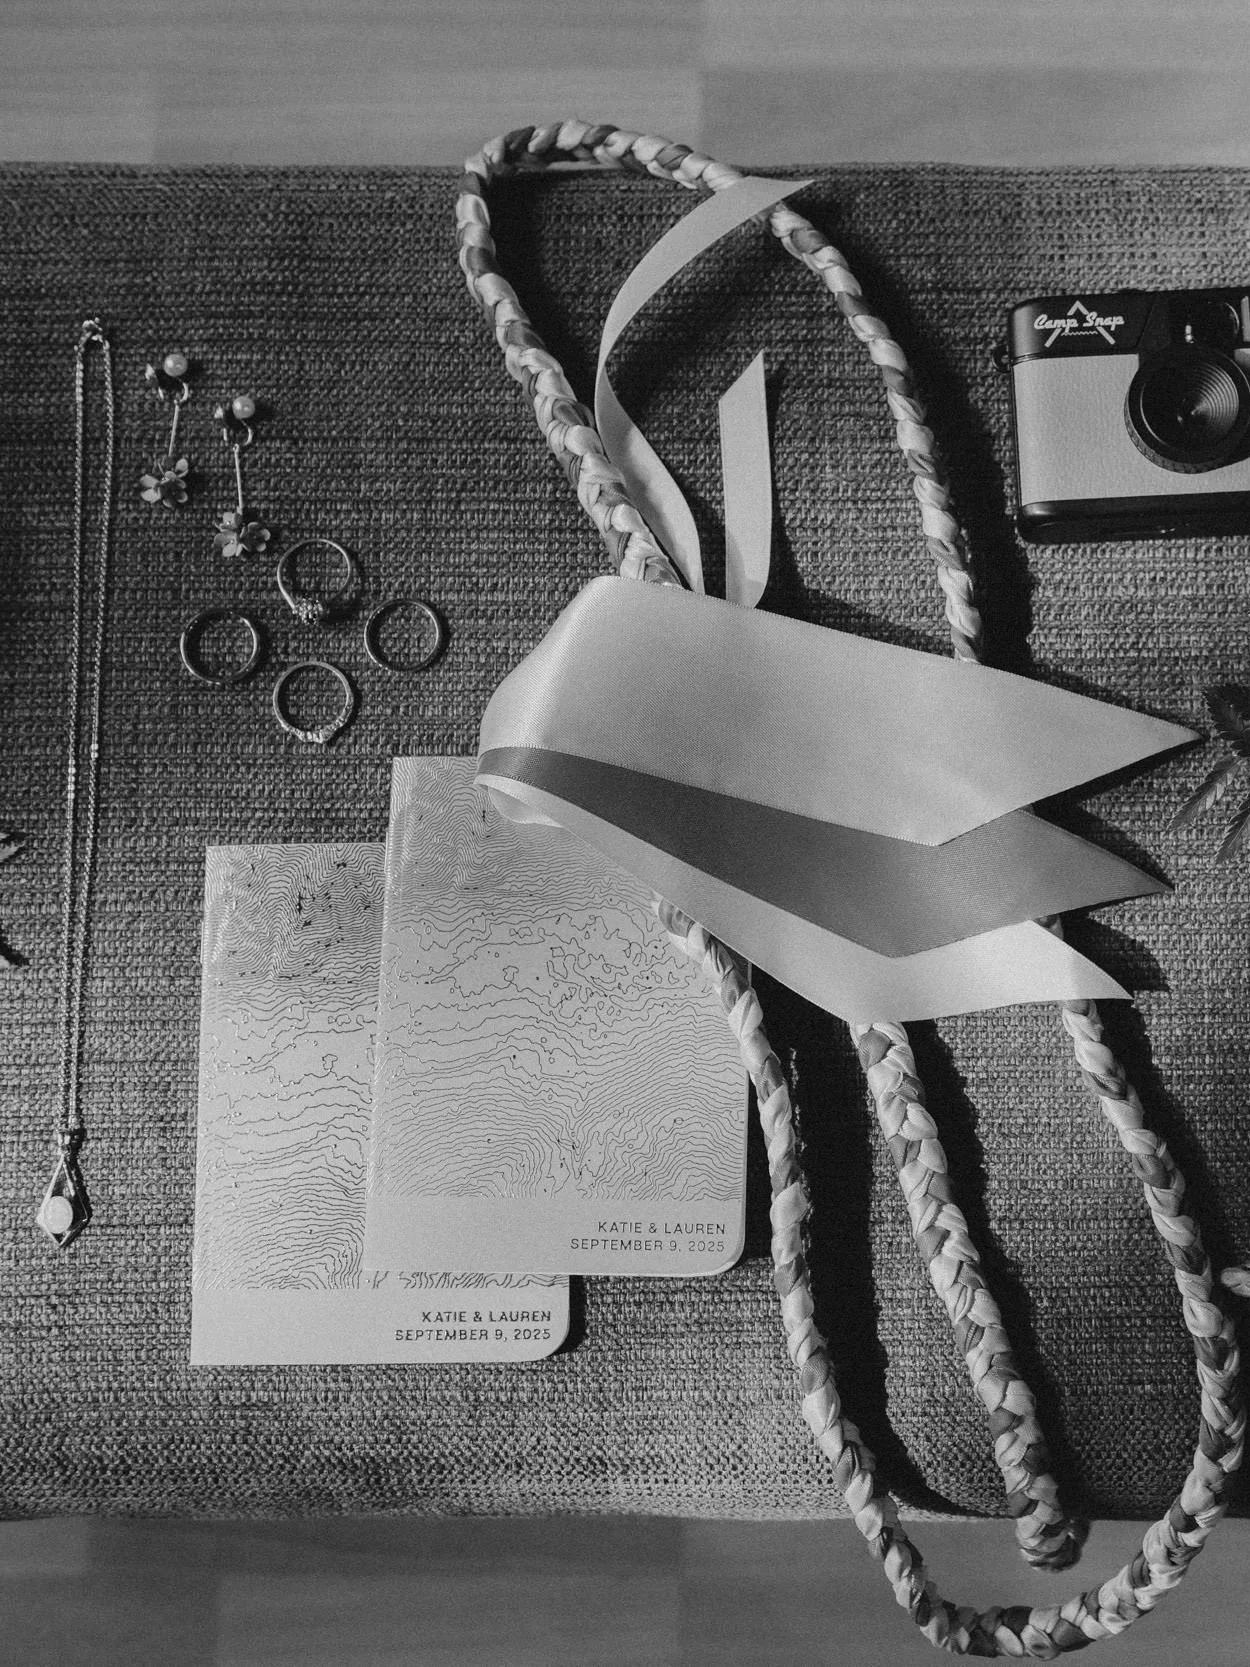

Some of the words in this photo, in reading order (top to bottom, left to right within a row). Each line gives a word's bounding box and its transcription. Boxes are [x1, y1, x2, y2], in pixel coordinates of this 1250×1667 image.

[1033, 313, 1079, 333] Camp
[1082, 311, 1125, 331] Snap
[598, 1221, 643, 1234] KATIE
[648, 1222, 658, 1234] &
[664, 1223, 726, 1235] LAUREN
[570, 1238, 663, 1251] SEPTEMBER
[688, 1240, 725, 1252] 2025
[421, 1311, 467, 1323] KATIE
[472, 1311, 483, 1323] &
[488, 1310, 551, 1323] LAUREN
[395, 1329, 488, 1341] SEPTEMBER
[494, 1329, 508, 1342] 9,
[513, 1328, 551, 1341] 2025
